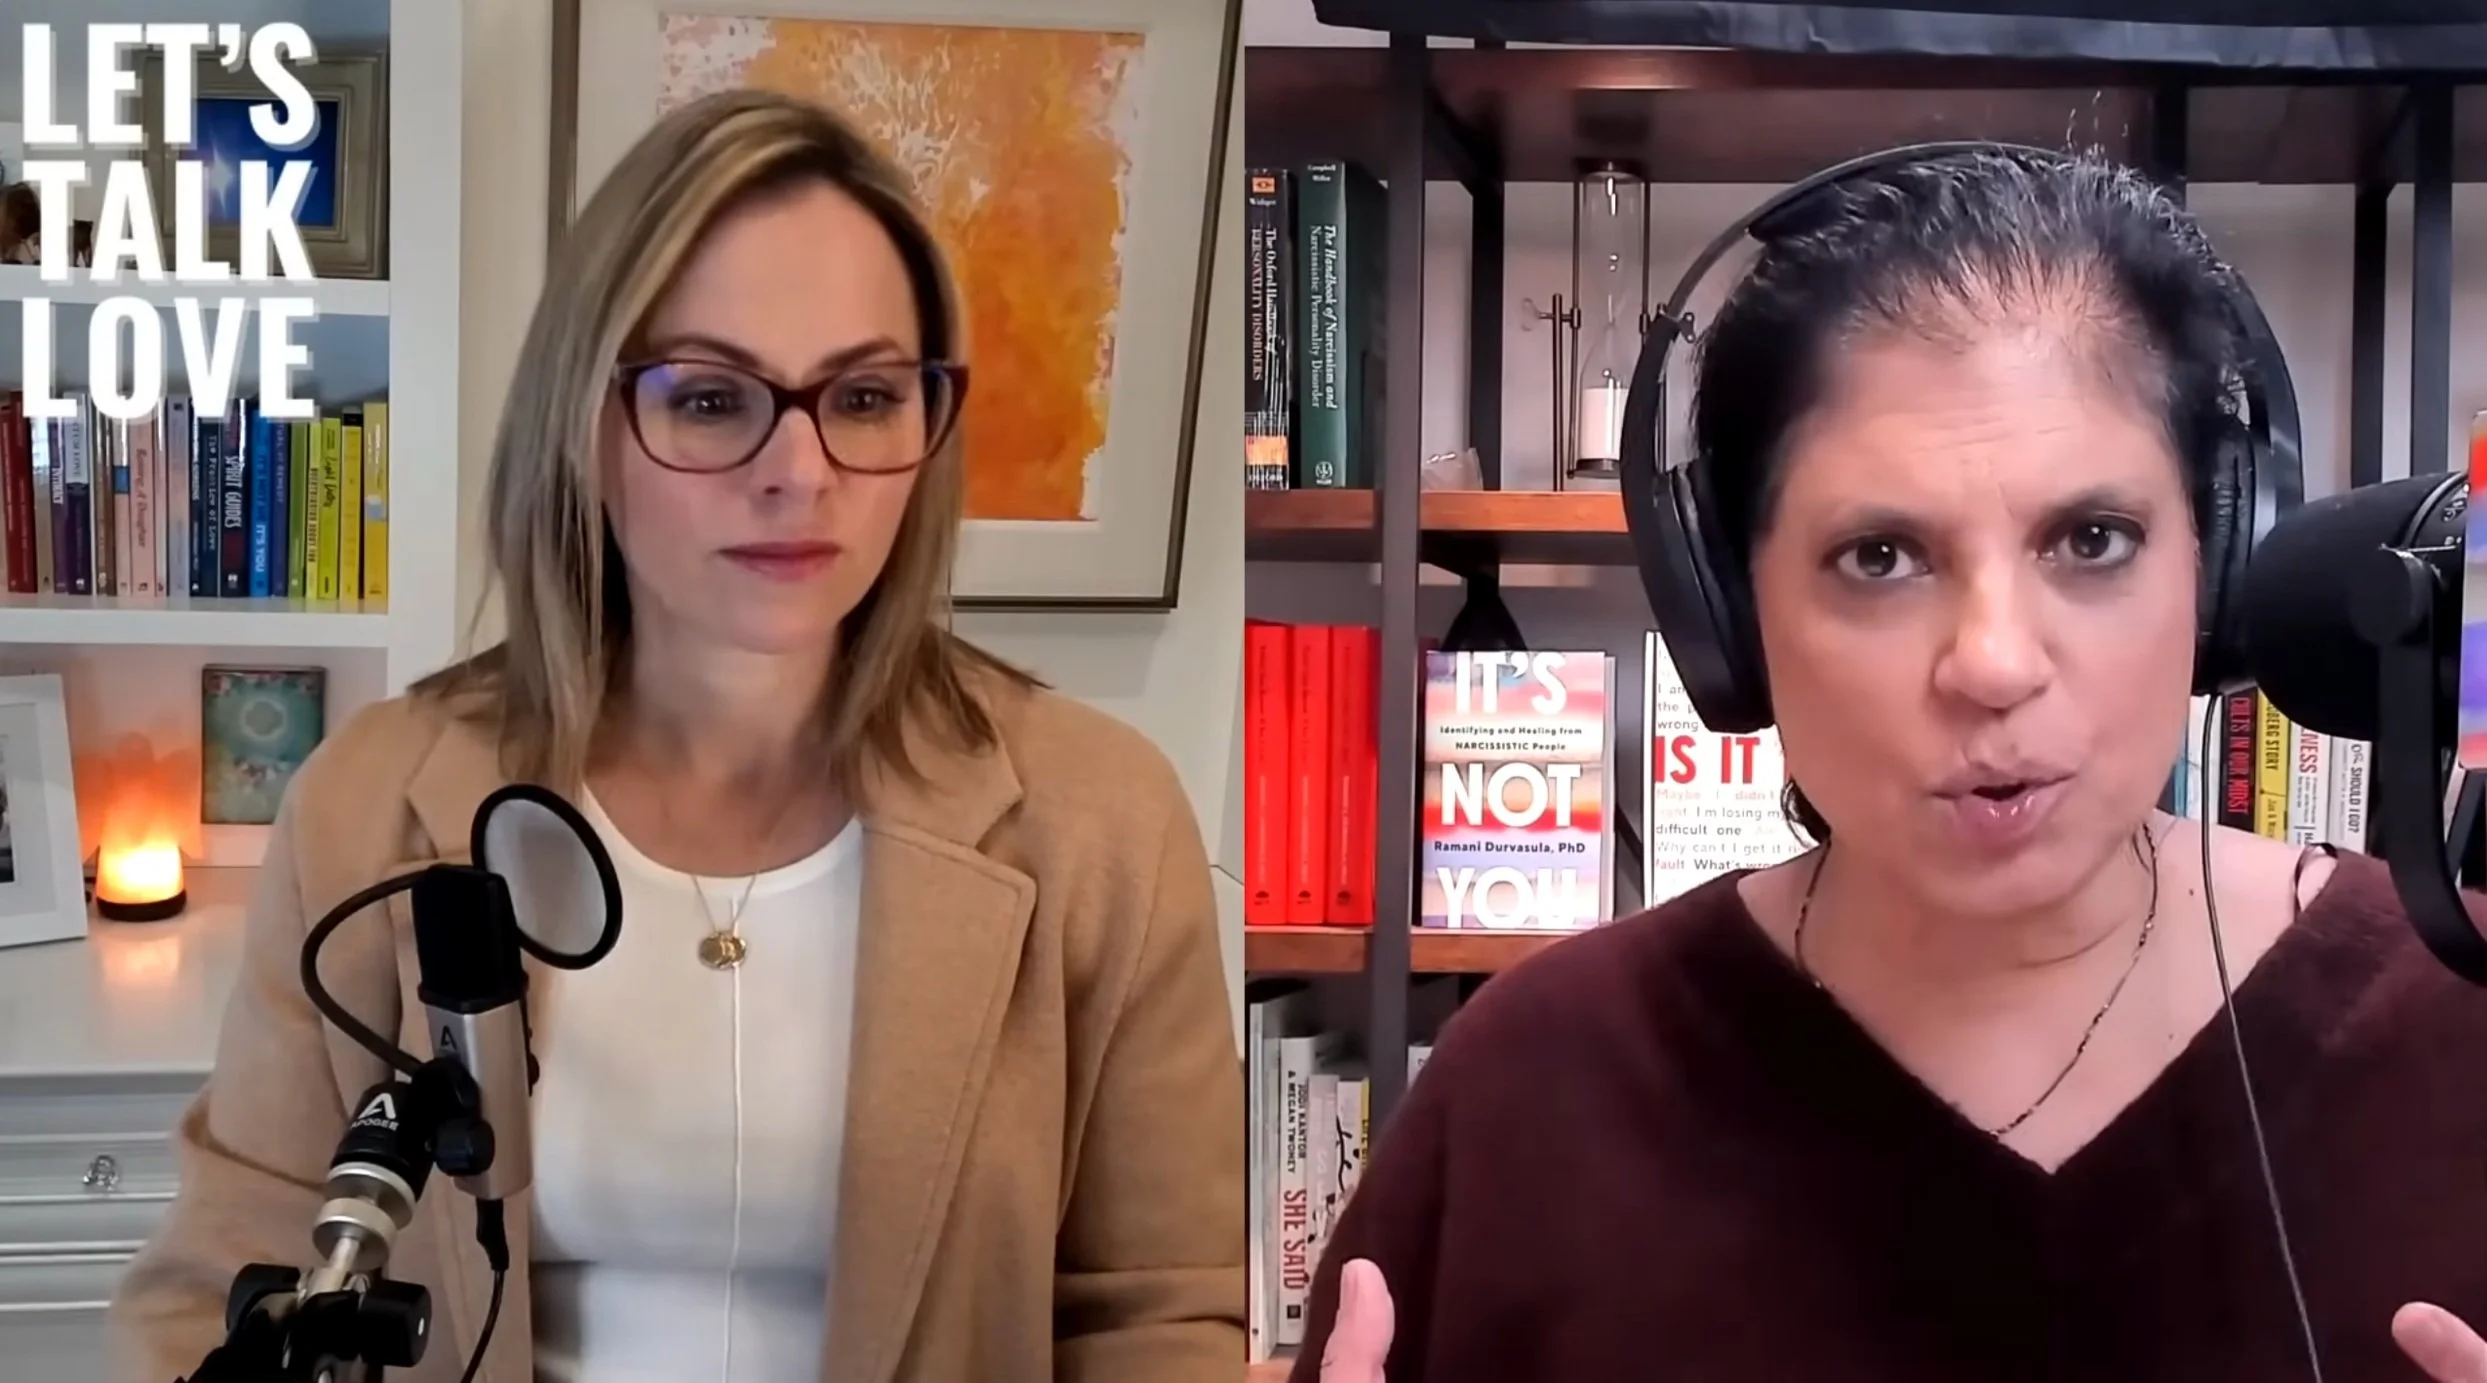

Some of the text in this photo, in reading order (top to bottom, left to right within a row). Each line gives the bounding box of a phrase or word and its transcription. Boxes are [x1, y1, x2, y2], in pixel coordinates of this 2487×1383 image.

[1265, 228, 1277, 249] The
[1251, 229, 1263, 381] PERSONALITY DISORDERS
[1308, 226, 1322, 408] Narcissistic Personality Disorder
[1322, 225, 1338, 408] The Handbook of Narcissism and
[225, 455, 243, 528] SPIRIT GUIDES
[256, 524, 266, 545] IT'S
[256, 549, 265, 573] YOU
[1455, 651, 1567, 716] IT'S
[1657, 701, 1680, 712] the
[1440, 725, 1582, 736] Identifying and Healing from
[1657, 720, 1699, 732] wrong
[1455, 742, 1566, 752] NARCISSISTIC People
[1654, 735, 1760, 784] IS IT
[2227, 697, 2251, 815] CULTS IN OUR MIDST
[2265, 739, 2279, 772] STORY
[1440, 762, 1581, 827] NOT
[2349, 767, 2363, 806] SHOULD
[1655, 824, 1708, 835] difficult
[1717, 825, 1742, 836] one
[1722, 807, 1762, 821] losing
[1434, 840, 1586, 855] Ramani Durvasula, PhD
[1656, 841, 1686, 855] Why
[1744, 843, 1765, 856] get
[1694, 859, 1743, 870] What's
[1436, 866, 1579, 929] YOU
[1287, 1083, 1296, 1123] MEGAN
[350, 1118, 400, 1131] APOGEE
[1297, 1113, 1307, 1159] KANTOR
[1286, 1127, 1296, 1174] TWOHEY
[1283, 1189, 1308, 1291] SHE SAID
